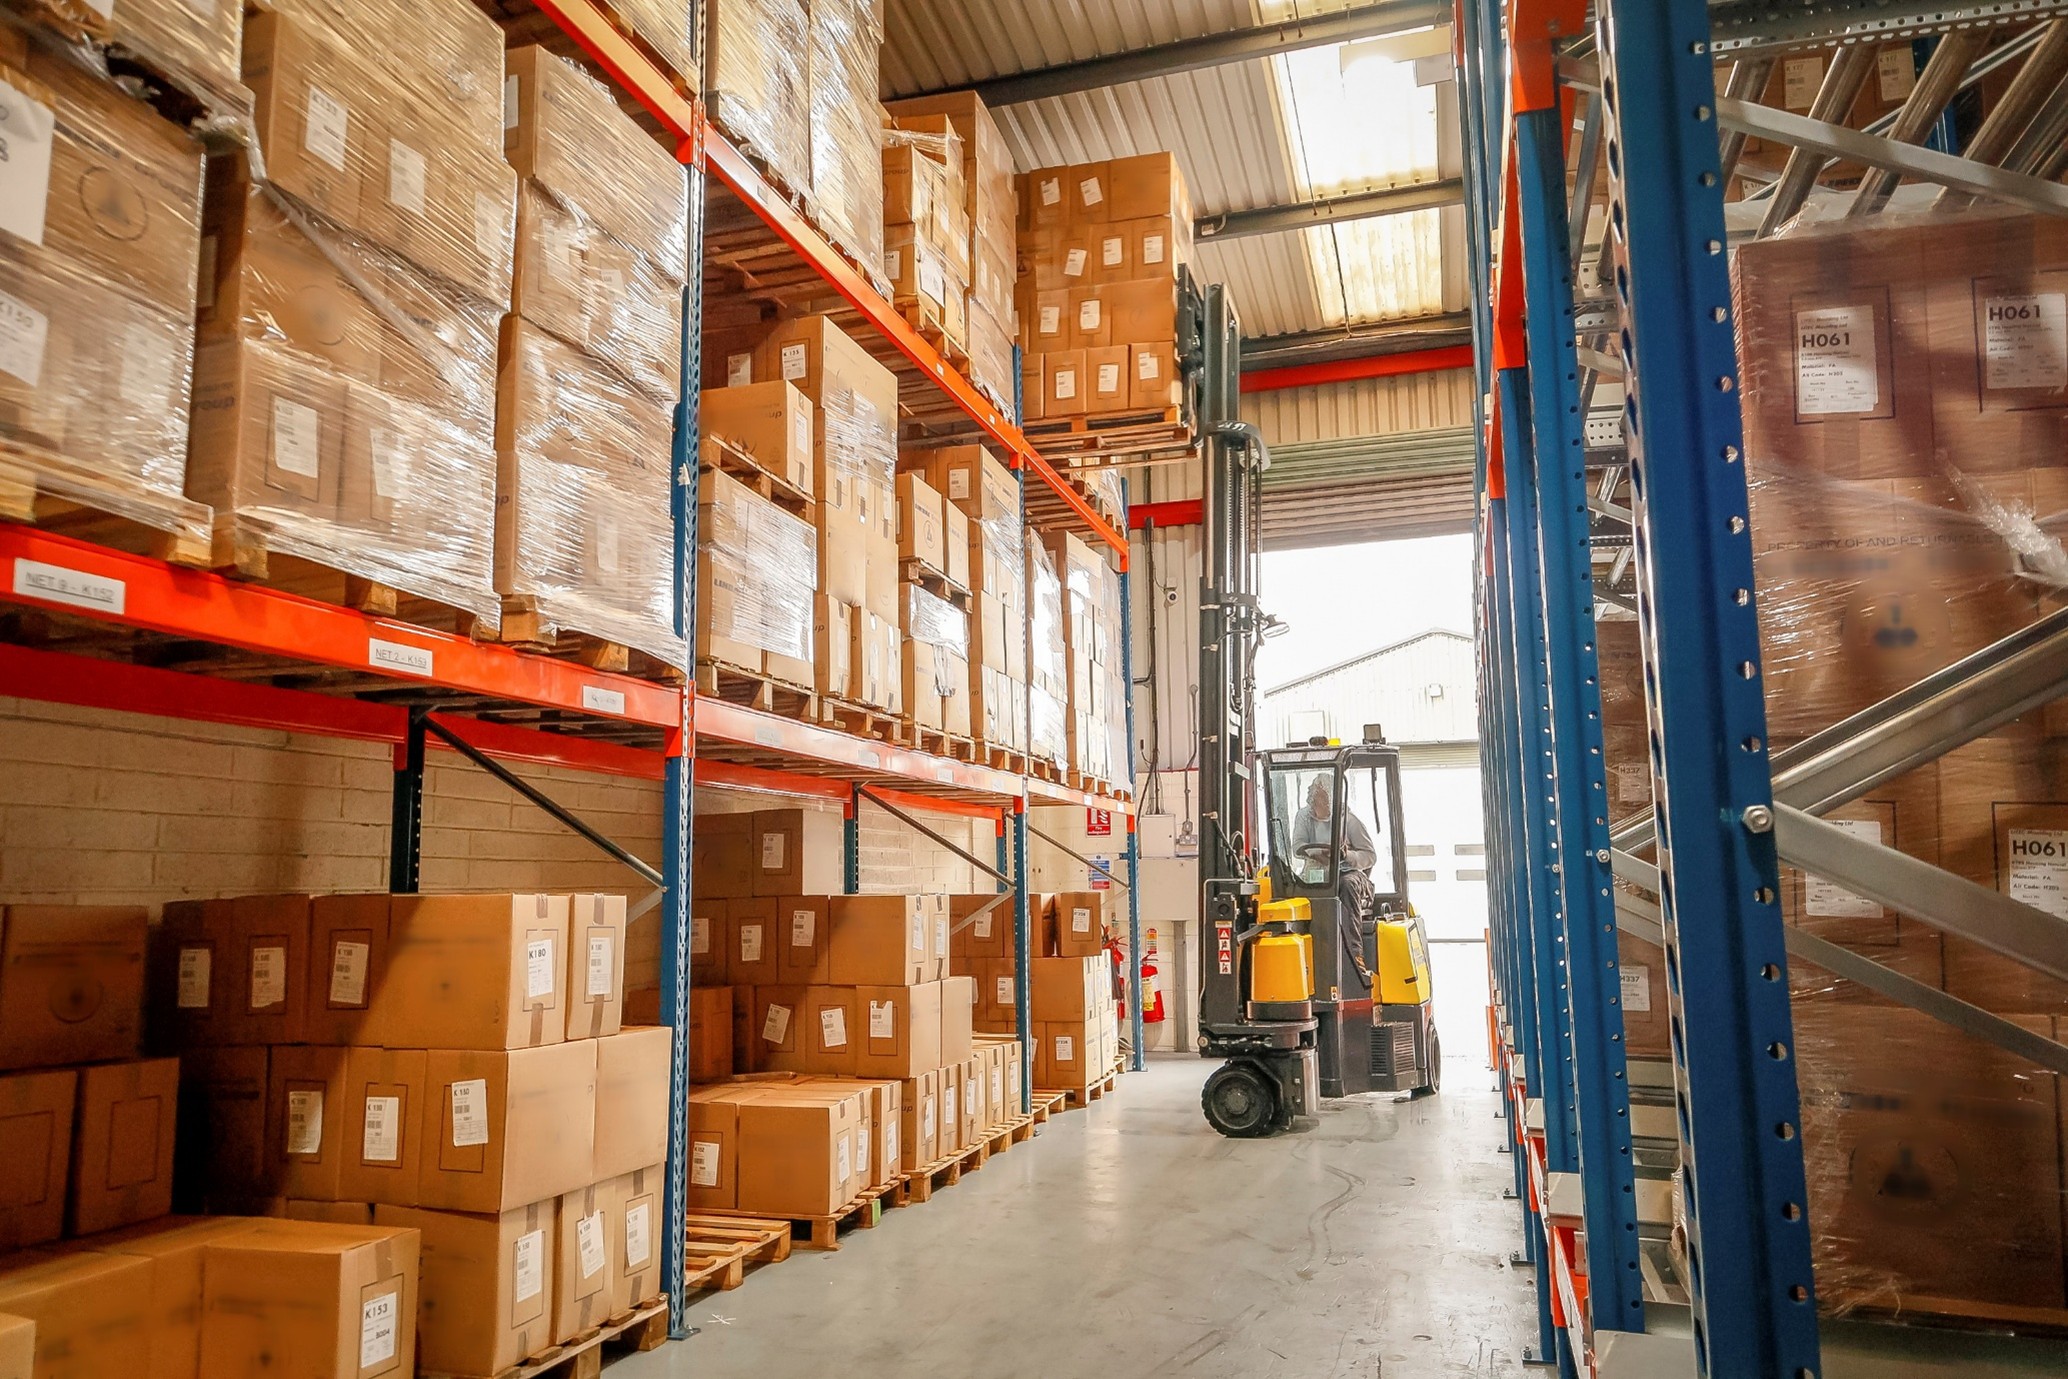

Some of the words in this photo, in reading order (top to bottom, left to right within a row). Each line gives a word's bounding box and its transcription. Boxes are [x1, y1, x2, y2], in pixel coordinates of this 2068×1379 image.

[1989, 305, 2041, 321] H061
[1802, 333, 1850, 348] H061
[1768, 539, 1841, 551] PROPERTY
[1867, 536, 1896, 548] AND
[25, 571, 55, 587] NET
[376, 648, 393, 659] NET
[2013, 840, 2066, 857] H061
[529, 948, 547, 959] K180
[365, 1303, 388, 1319] K153
